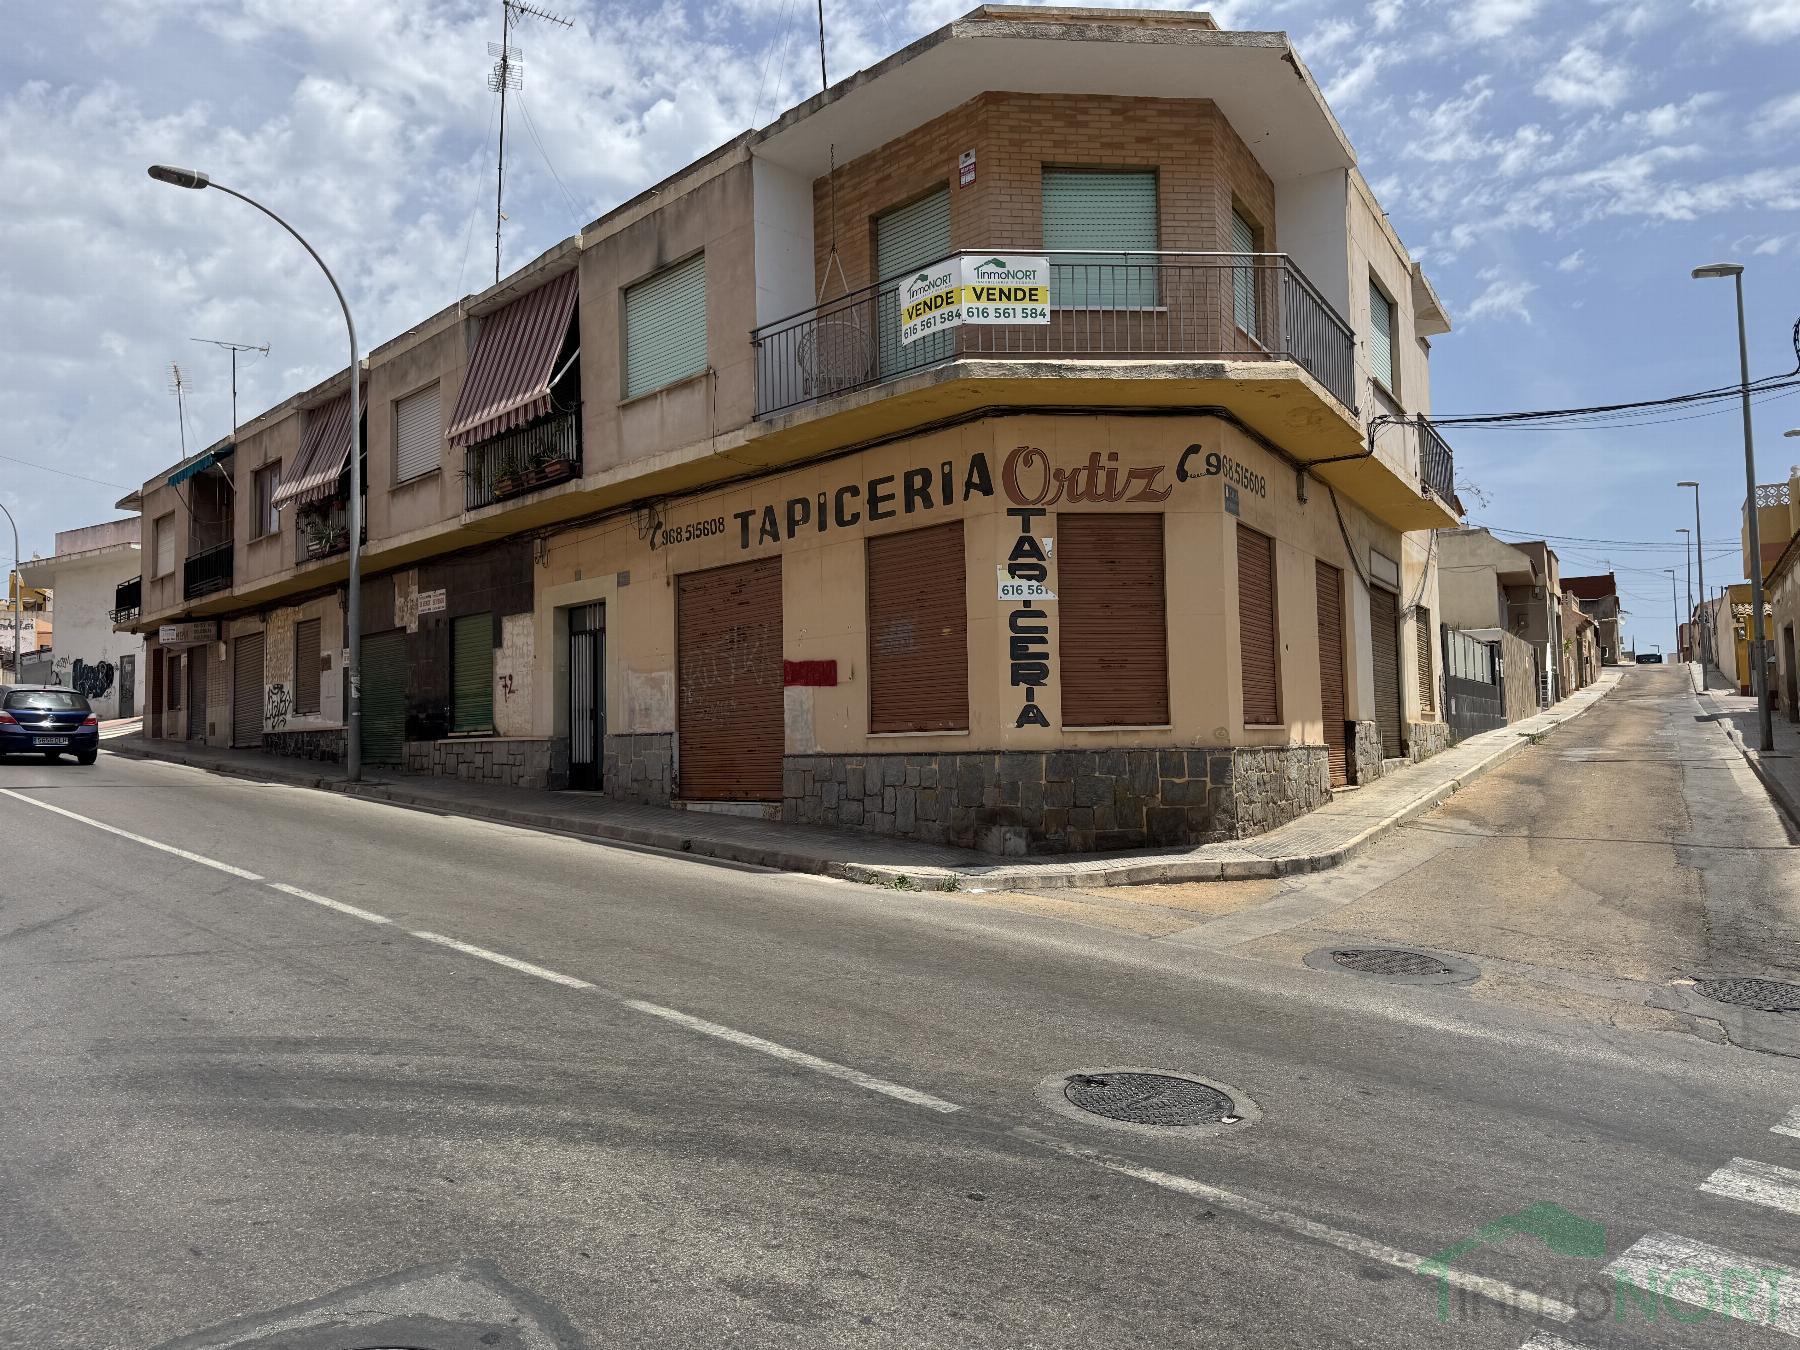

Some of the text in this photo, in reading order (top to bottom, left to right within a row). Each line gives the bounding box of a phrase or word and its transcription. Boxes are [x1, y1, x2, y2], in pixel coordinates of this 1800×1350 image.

[907, 290, 955, 320] VENDE
[972, 286, 1039, 302] VENDE
[904, 308, 961, 339] 616 561 584
[966, 306, 1047, 319] 616 561 584
[662, 516, 725, 546] 968.515608
[733, 452, 994, 549] TAPICERIA
[1001, 445, 1173, 507] Ortiz
[1001, 584, 1024, 596] 616
